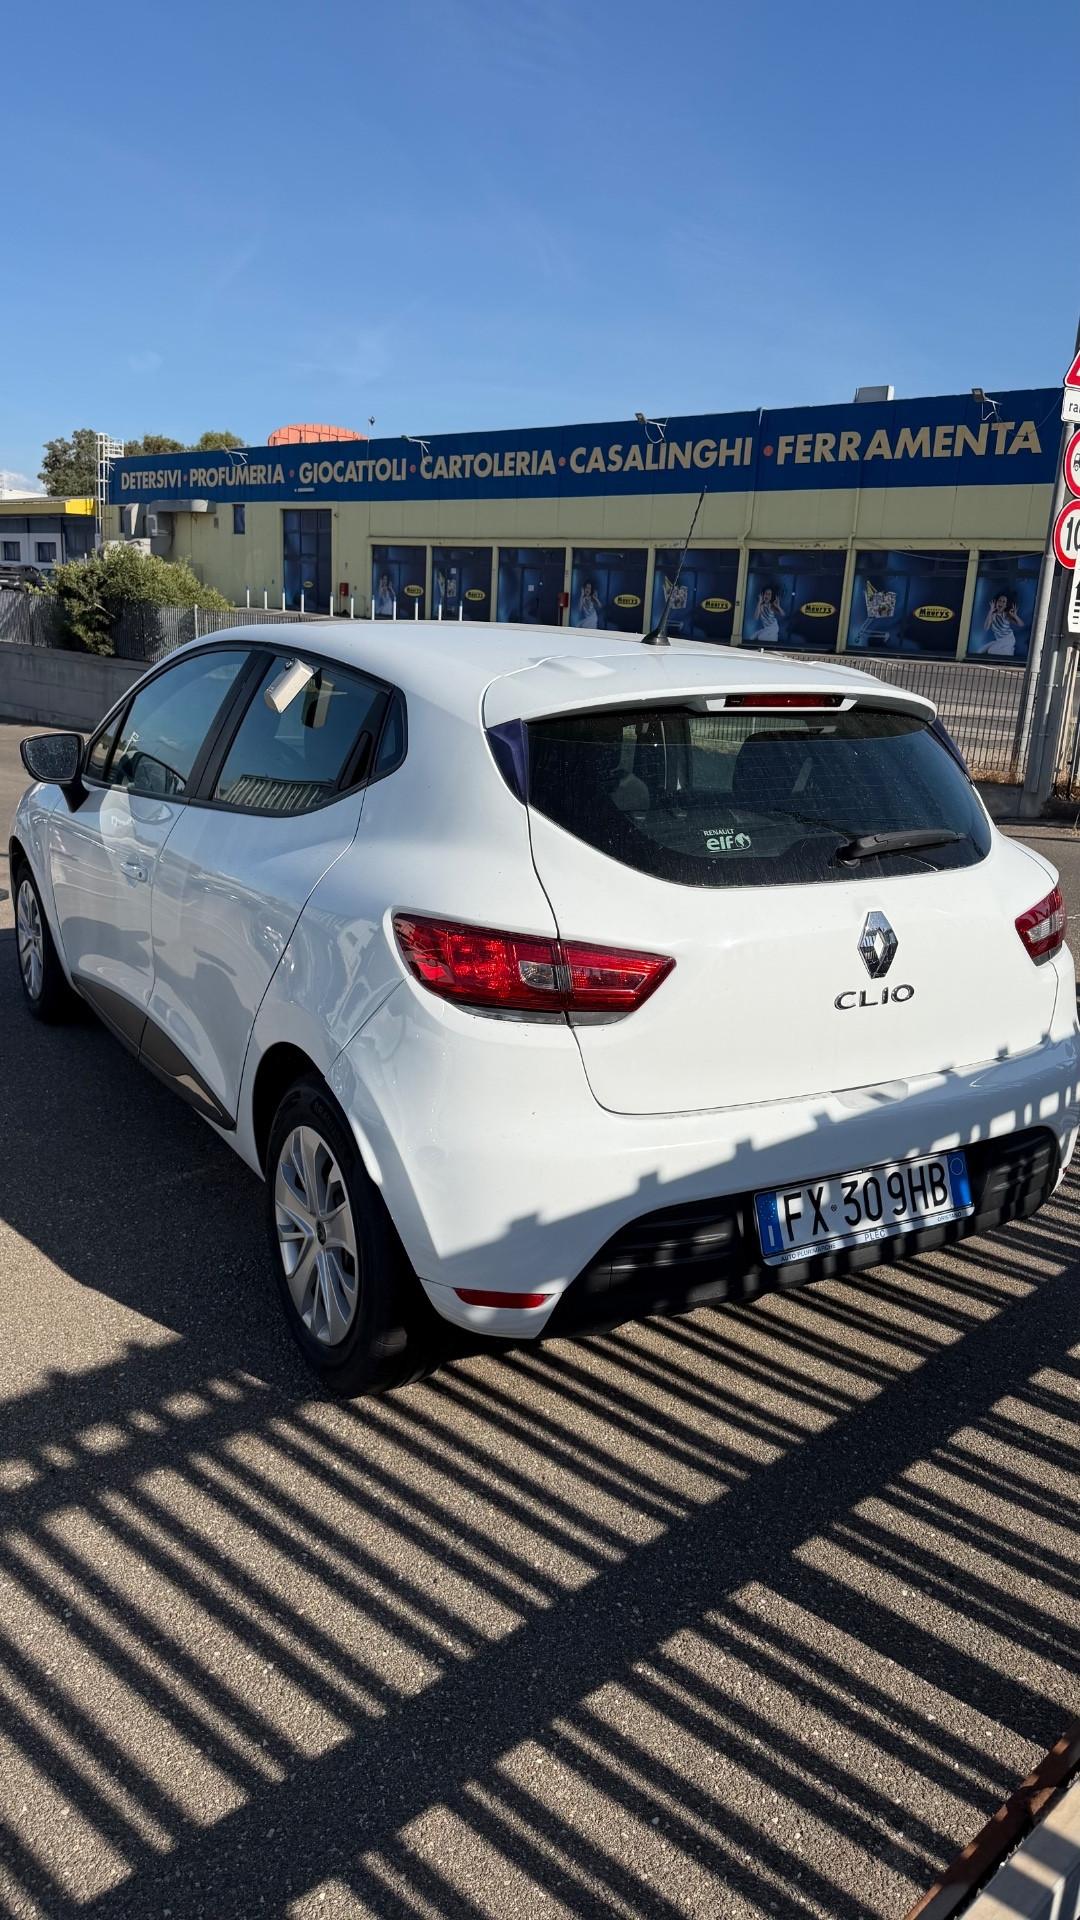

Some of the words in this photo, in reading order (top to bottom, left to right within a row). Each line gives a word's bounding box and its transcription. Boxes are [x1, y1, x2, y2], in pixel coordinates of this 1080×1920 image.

[121, 469, 182, 490] DETERSIVI
[189, 464, 285, 488] PROFUMERIA
[299, 457, 407, 484] GIOCATTOLI
[420, 450, 556, 480] CARTOLERIA
[569, 437, 753, 474] CASALINGHI
[776, 420, 1042, 465] FERRAMENTA
[703, 828, 735, 836] RENAULT
[706, 835, 735, 851] elf
[834, 983, 915, 1010] CLIO
[783, 1186, 830, 1242] FX
[841, 1162, 948, 1227] 309HB
